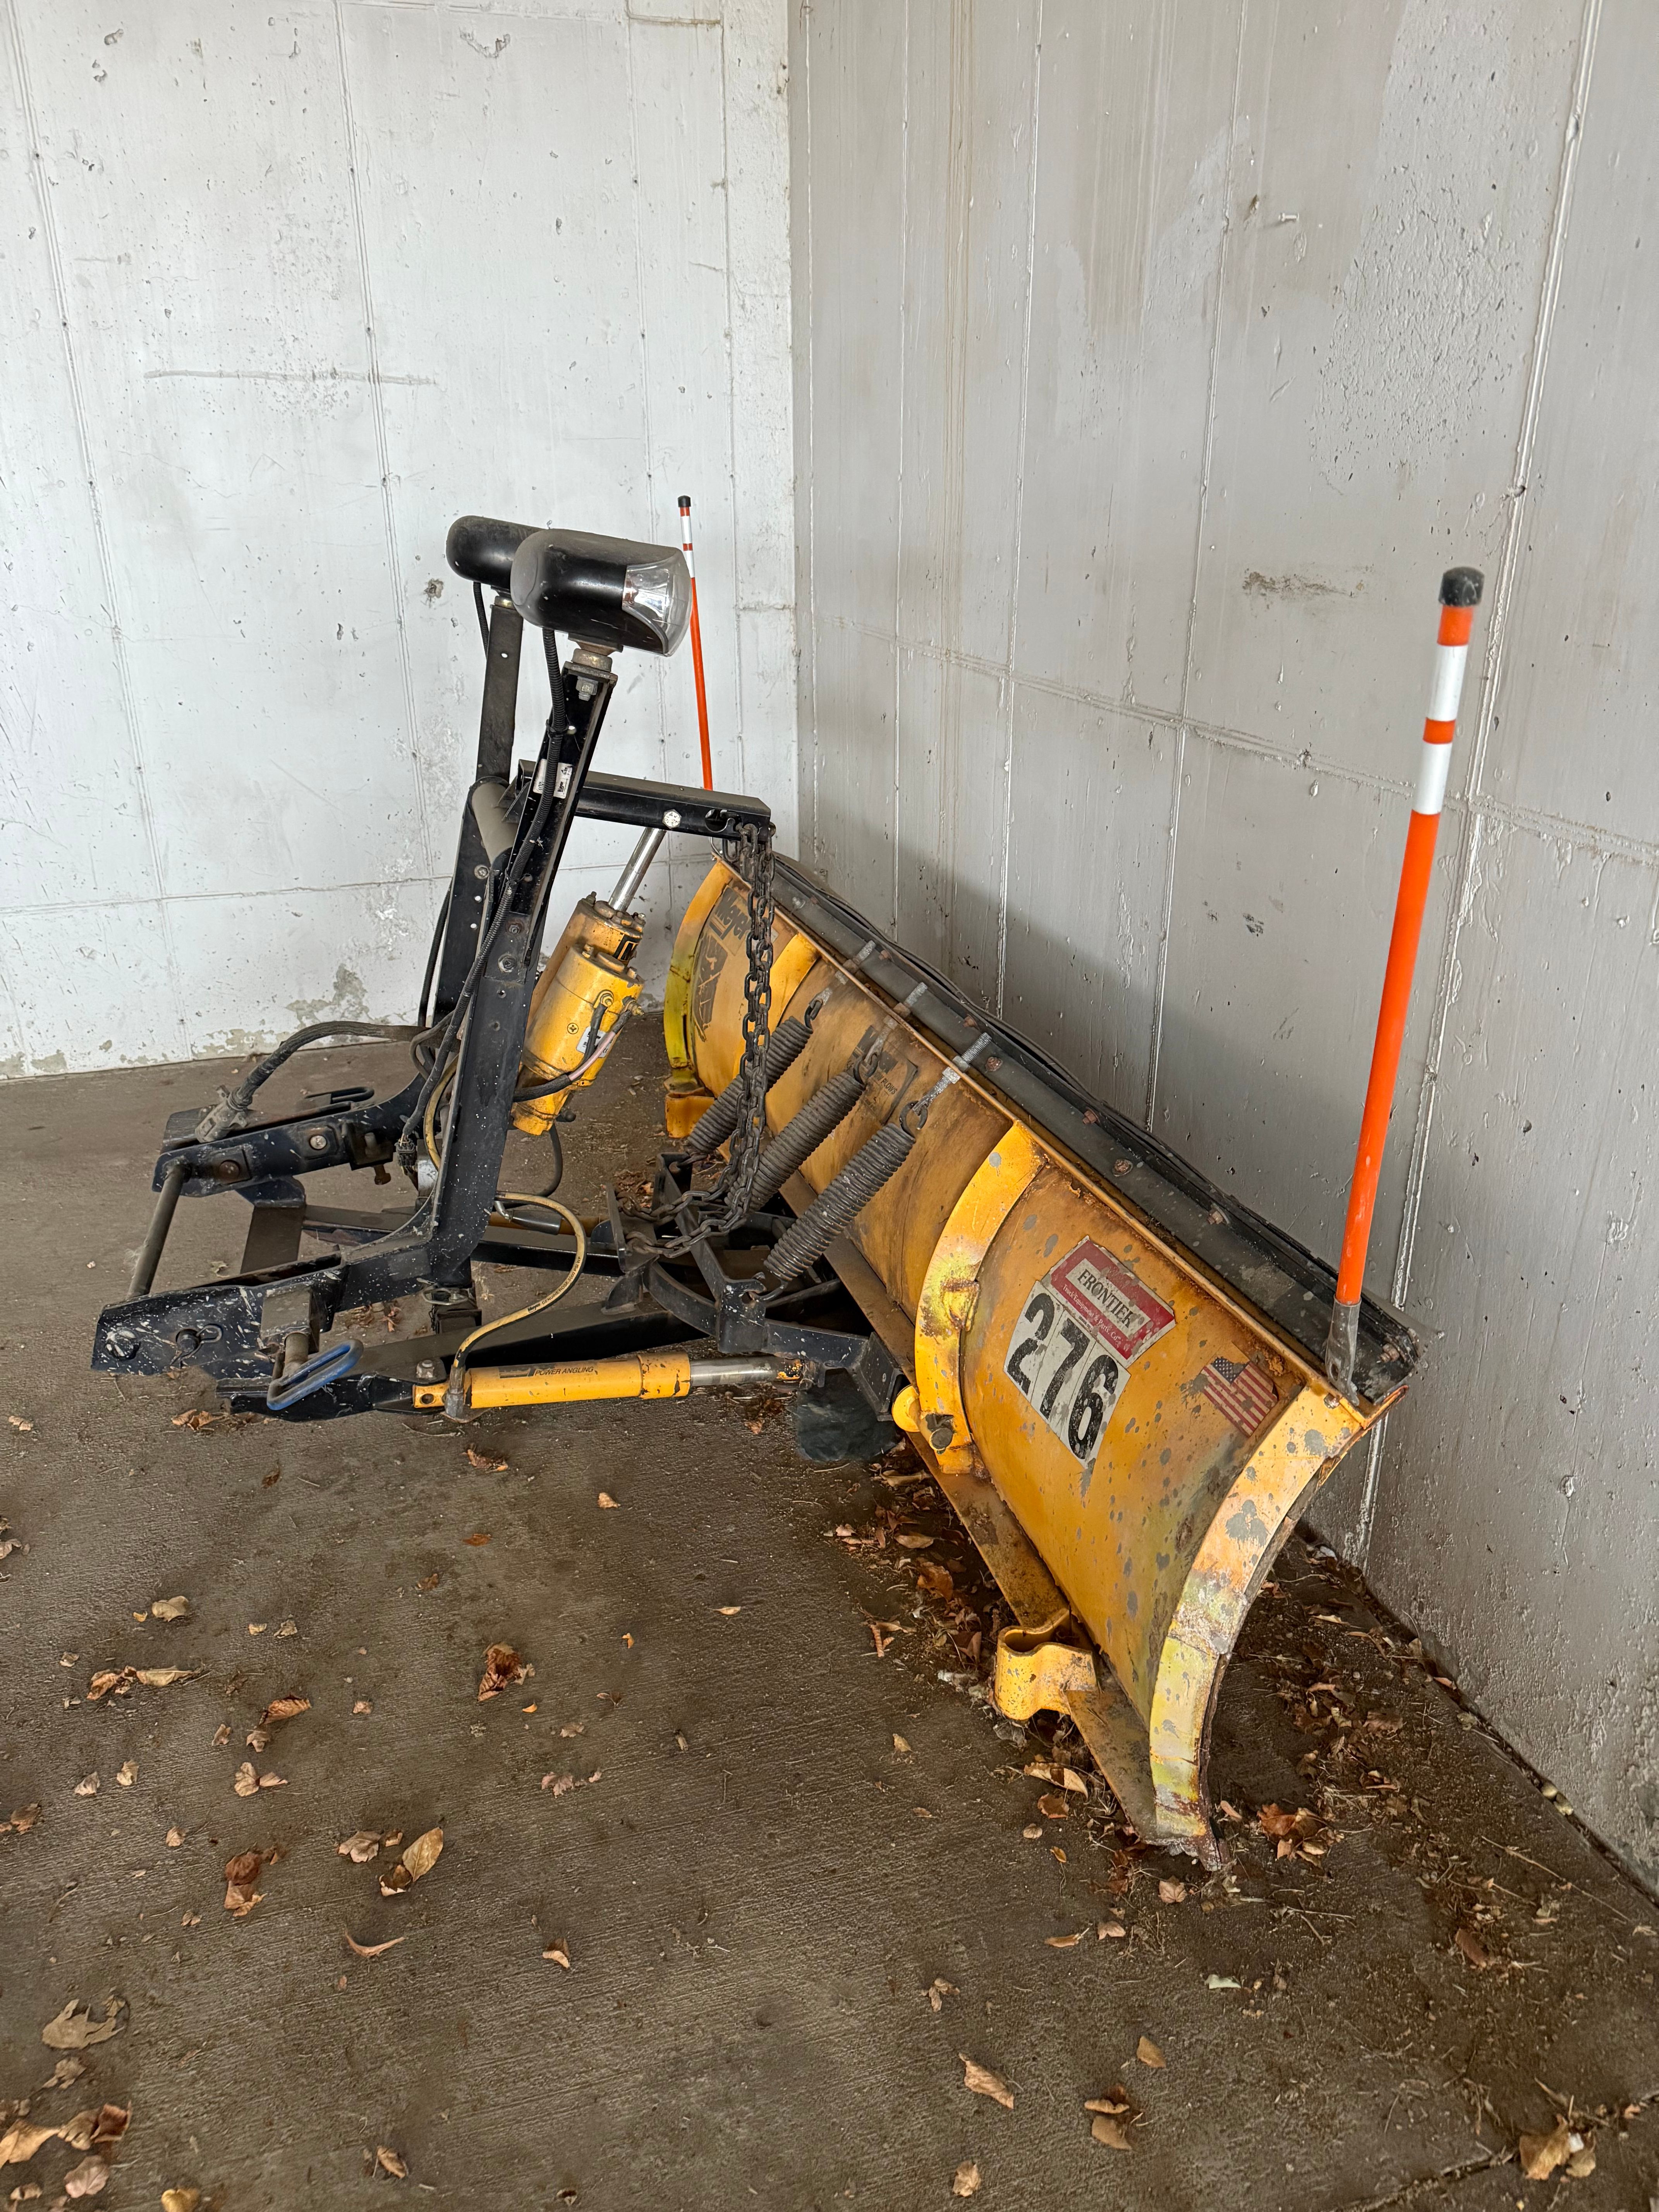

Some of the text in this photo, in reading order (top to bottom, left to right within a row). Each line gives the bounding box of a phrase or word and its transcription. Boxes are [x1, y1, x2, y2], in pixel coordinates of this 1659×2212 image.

[709, 887, 752, 941] Meyer
[881, 1078, 898, 1095] PLOWS
[542, 1291, 560, 1305] GENUINE
[559, 1282, 569, 1292] HOSE
[1063, 1284, 1074, 1298] Truck
[1073, 1293, 1094, 1317] Equipment
[1093, 1314, 1100, 1322] &
[1077, 1269, 1134, 1328] FRONTIER
[562, 1366, 594, 1374] ANGLING
[1007, 1292, 1119, 1460] 276
